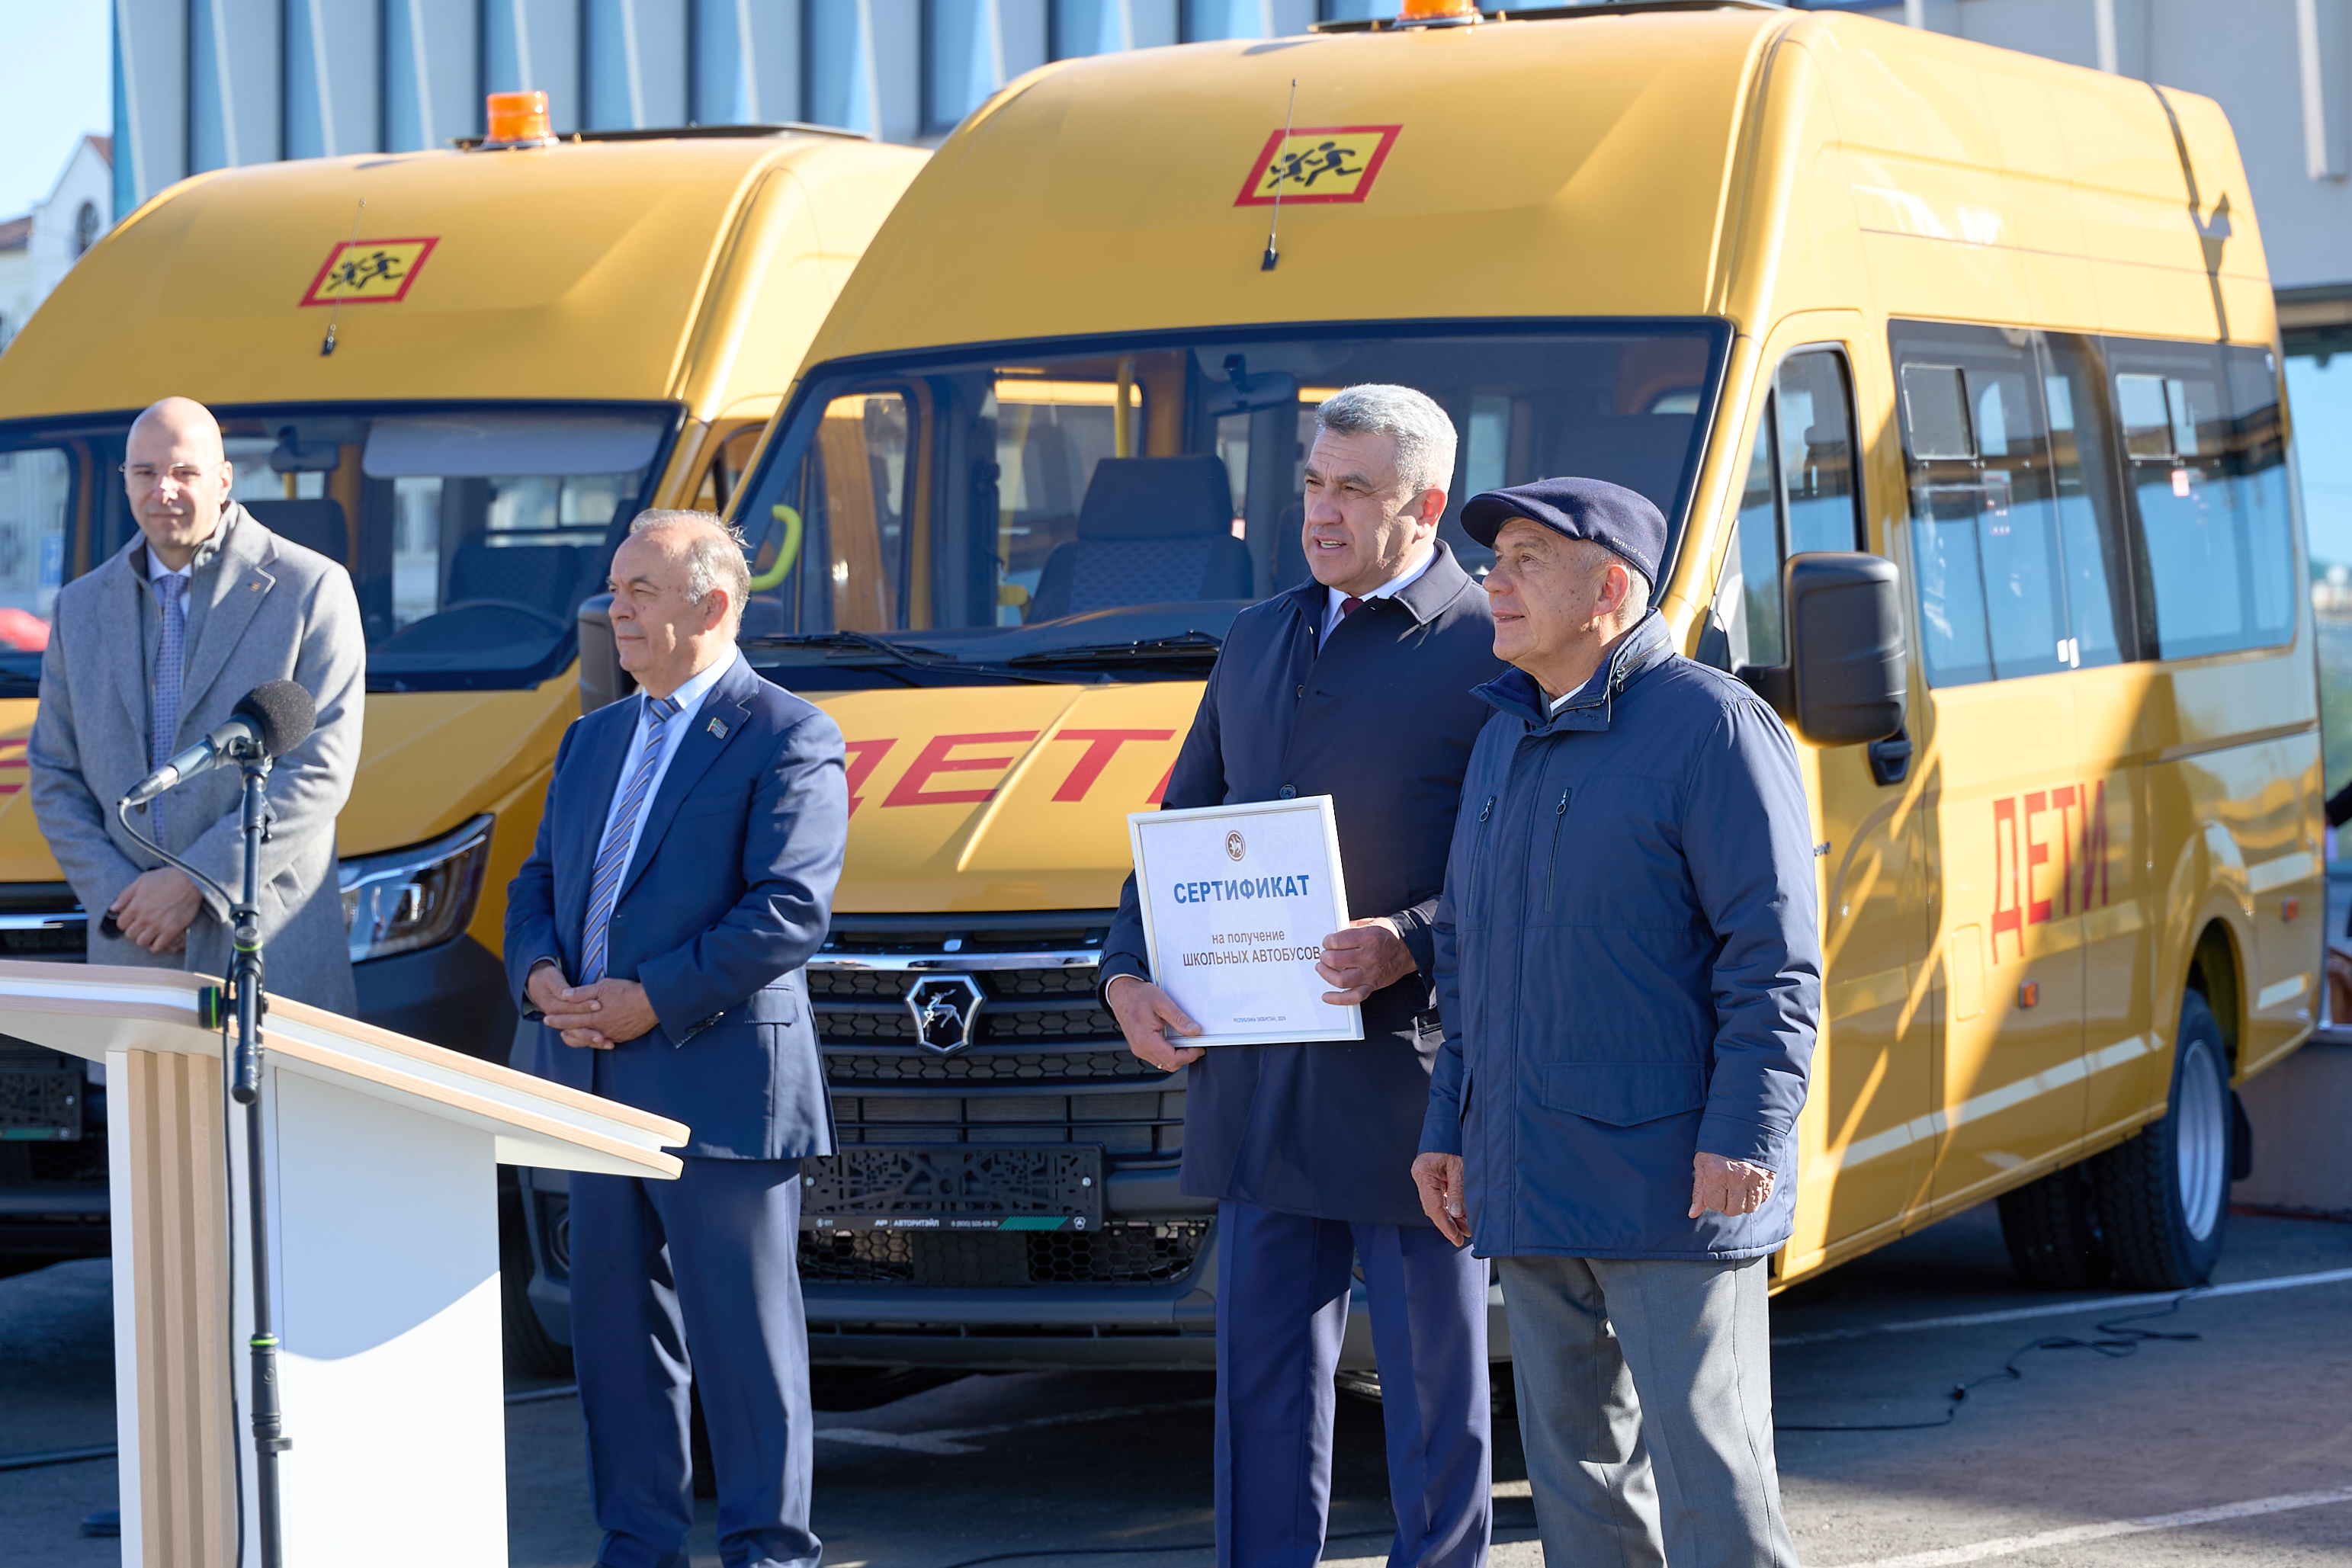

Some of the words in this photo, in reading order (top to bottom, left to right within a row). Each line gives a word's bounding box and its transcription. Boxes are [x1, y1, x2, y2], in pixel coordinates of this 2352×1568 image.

[846, 729, 1178, 821] ЕТ
[1991, 780, 2108, 965] ДЕТИ
[1174, 874, 1310, 904] СЕРТИФИКАТ
[1211, 934, 1224, 944] на
[1227, 930, 1285, 945] получение
[1182, 950, 1250, 967] ШКОЛЬНЫХ
[1253, 946, 1321, 963] АВТОБУСОВ
[894, 1218, 939, 1227] АВТОРИТЭЙЛ
